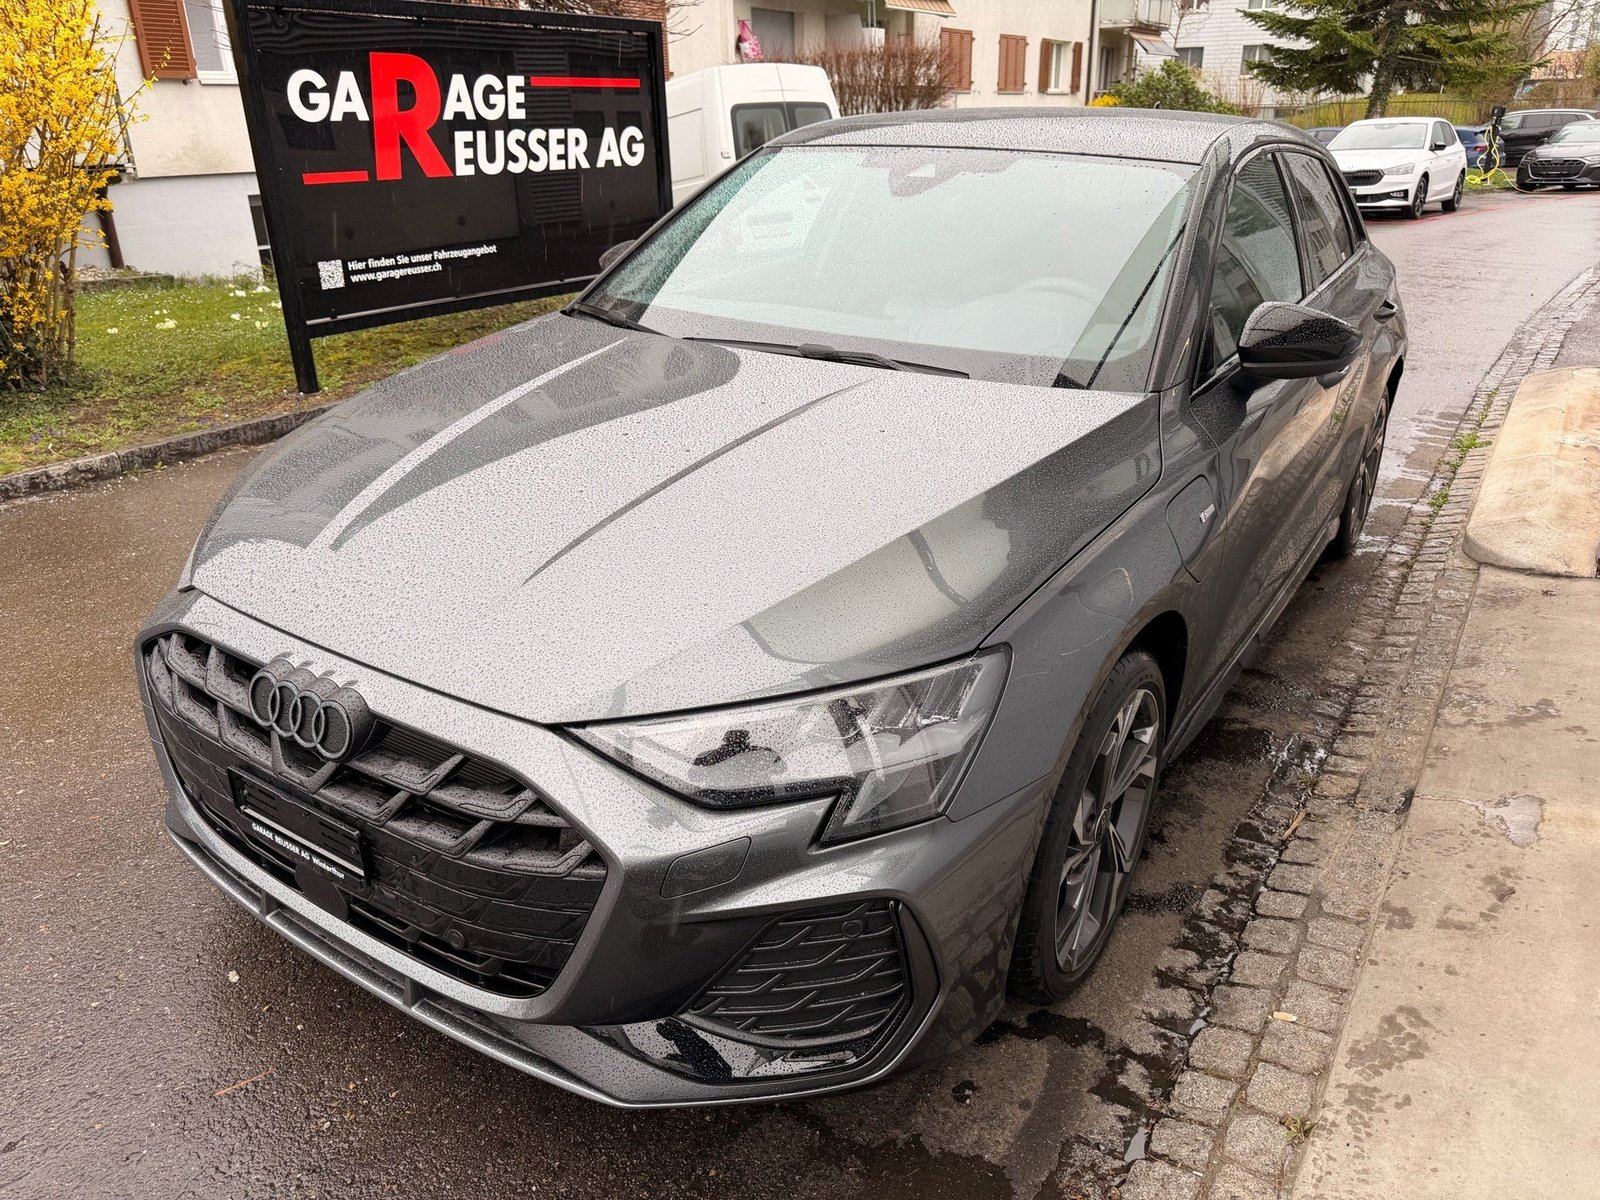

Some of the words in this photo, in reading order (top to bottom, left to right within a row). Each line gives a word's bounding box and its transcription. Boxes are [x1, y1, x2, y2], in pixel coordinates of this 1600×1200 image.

[286, 52, 526, 181] GARAGE
[596, 125, 645, 168] AG
[347, 260, 366, 271] Hier
[367, 256, 396, 269] finden
[396, 254, 410, 265] Sie
[410, 252, 433, 263] unser
[433, 244, 498, 261] Fahrzeugangebot
[350, 262, 443, 283] www.garagereusser.ch
[251, 822, 274, 840] GARAGE
[274, 835, 300, 855] REUSSER
[300, 849, 310, 860] AG
